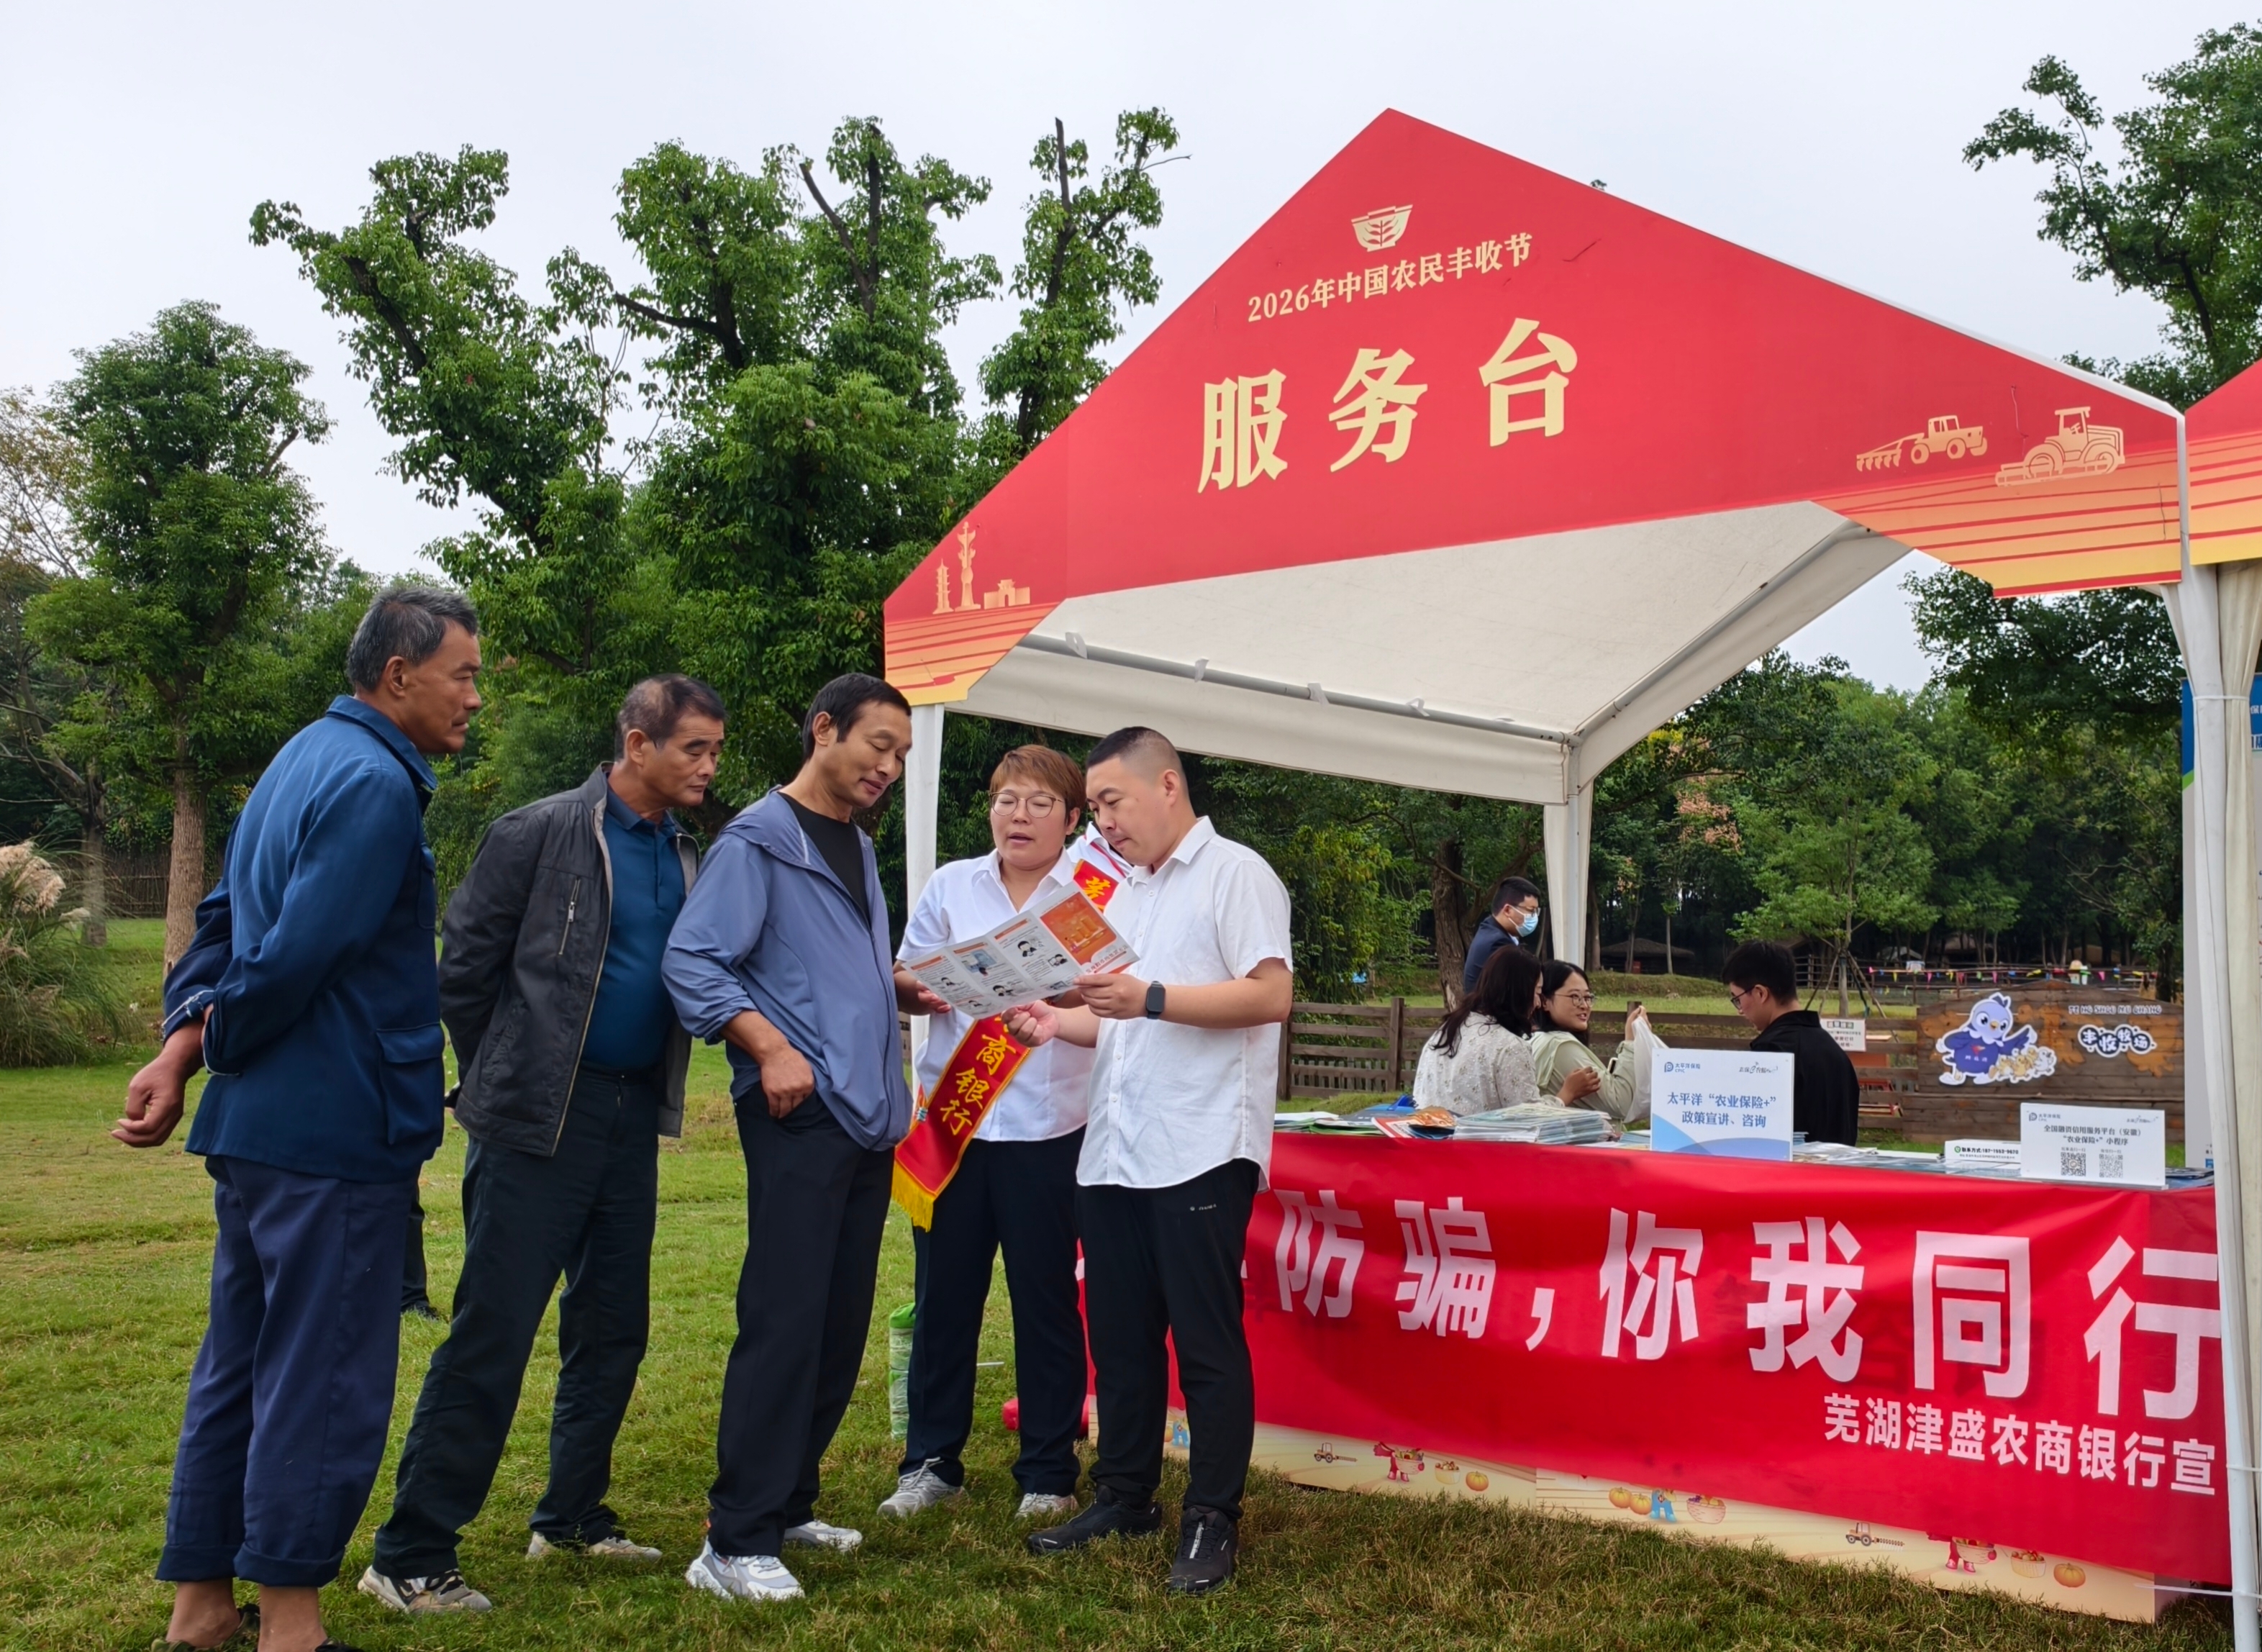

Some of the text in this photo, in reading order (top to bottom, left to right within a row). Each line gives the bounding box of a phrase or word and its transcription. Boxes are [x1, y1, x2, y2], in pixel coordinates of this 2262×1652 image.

[1248, 232, 1533, 322] 2026年中国农民丰收节
[1197, 317, 1578, 494] 服务台
[940, 1016, 1017, 1136] 商银行
[2082, 1028, 2149, 1052] 丰收牧场
[1681, 1111, 1766, 1128] 政策宣讲、咨询
[1240, 1189, 2222, 1420] 防骗，你我同行
[1824, 1393, 2215, 1496] 芜湖津盛农商银行宣
